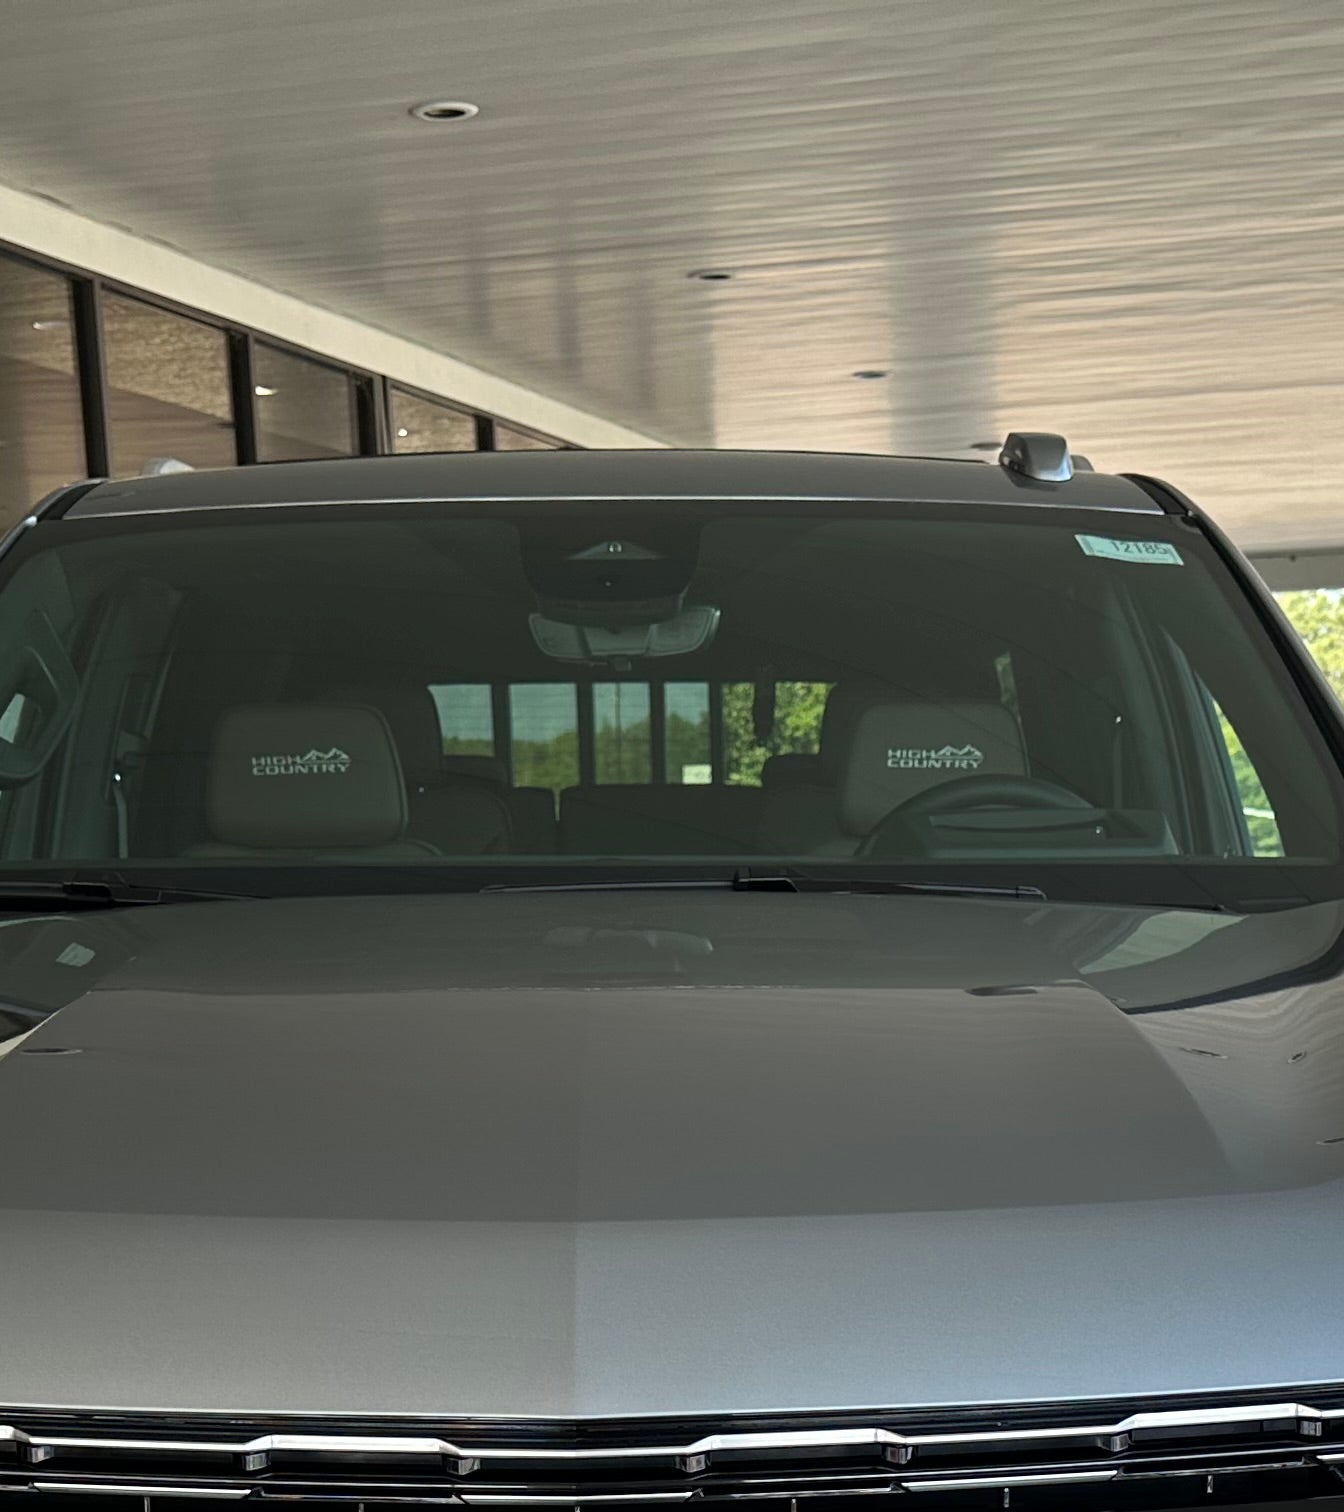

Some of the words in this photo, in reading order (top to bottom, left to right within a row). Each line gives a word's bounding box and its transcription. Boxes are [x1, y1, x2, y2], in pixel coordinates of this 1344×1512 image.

[887, 749, 936, 759] HIGH
[251, 755, 301, 766] HIGH
[887, 759, 982, 769] COUNTRY
[252, 763, 350, 775] COUNTRY
